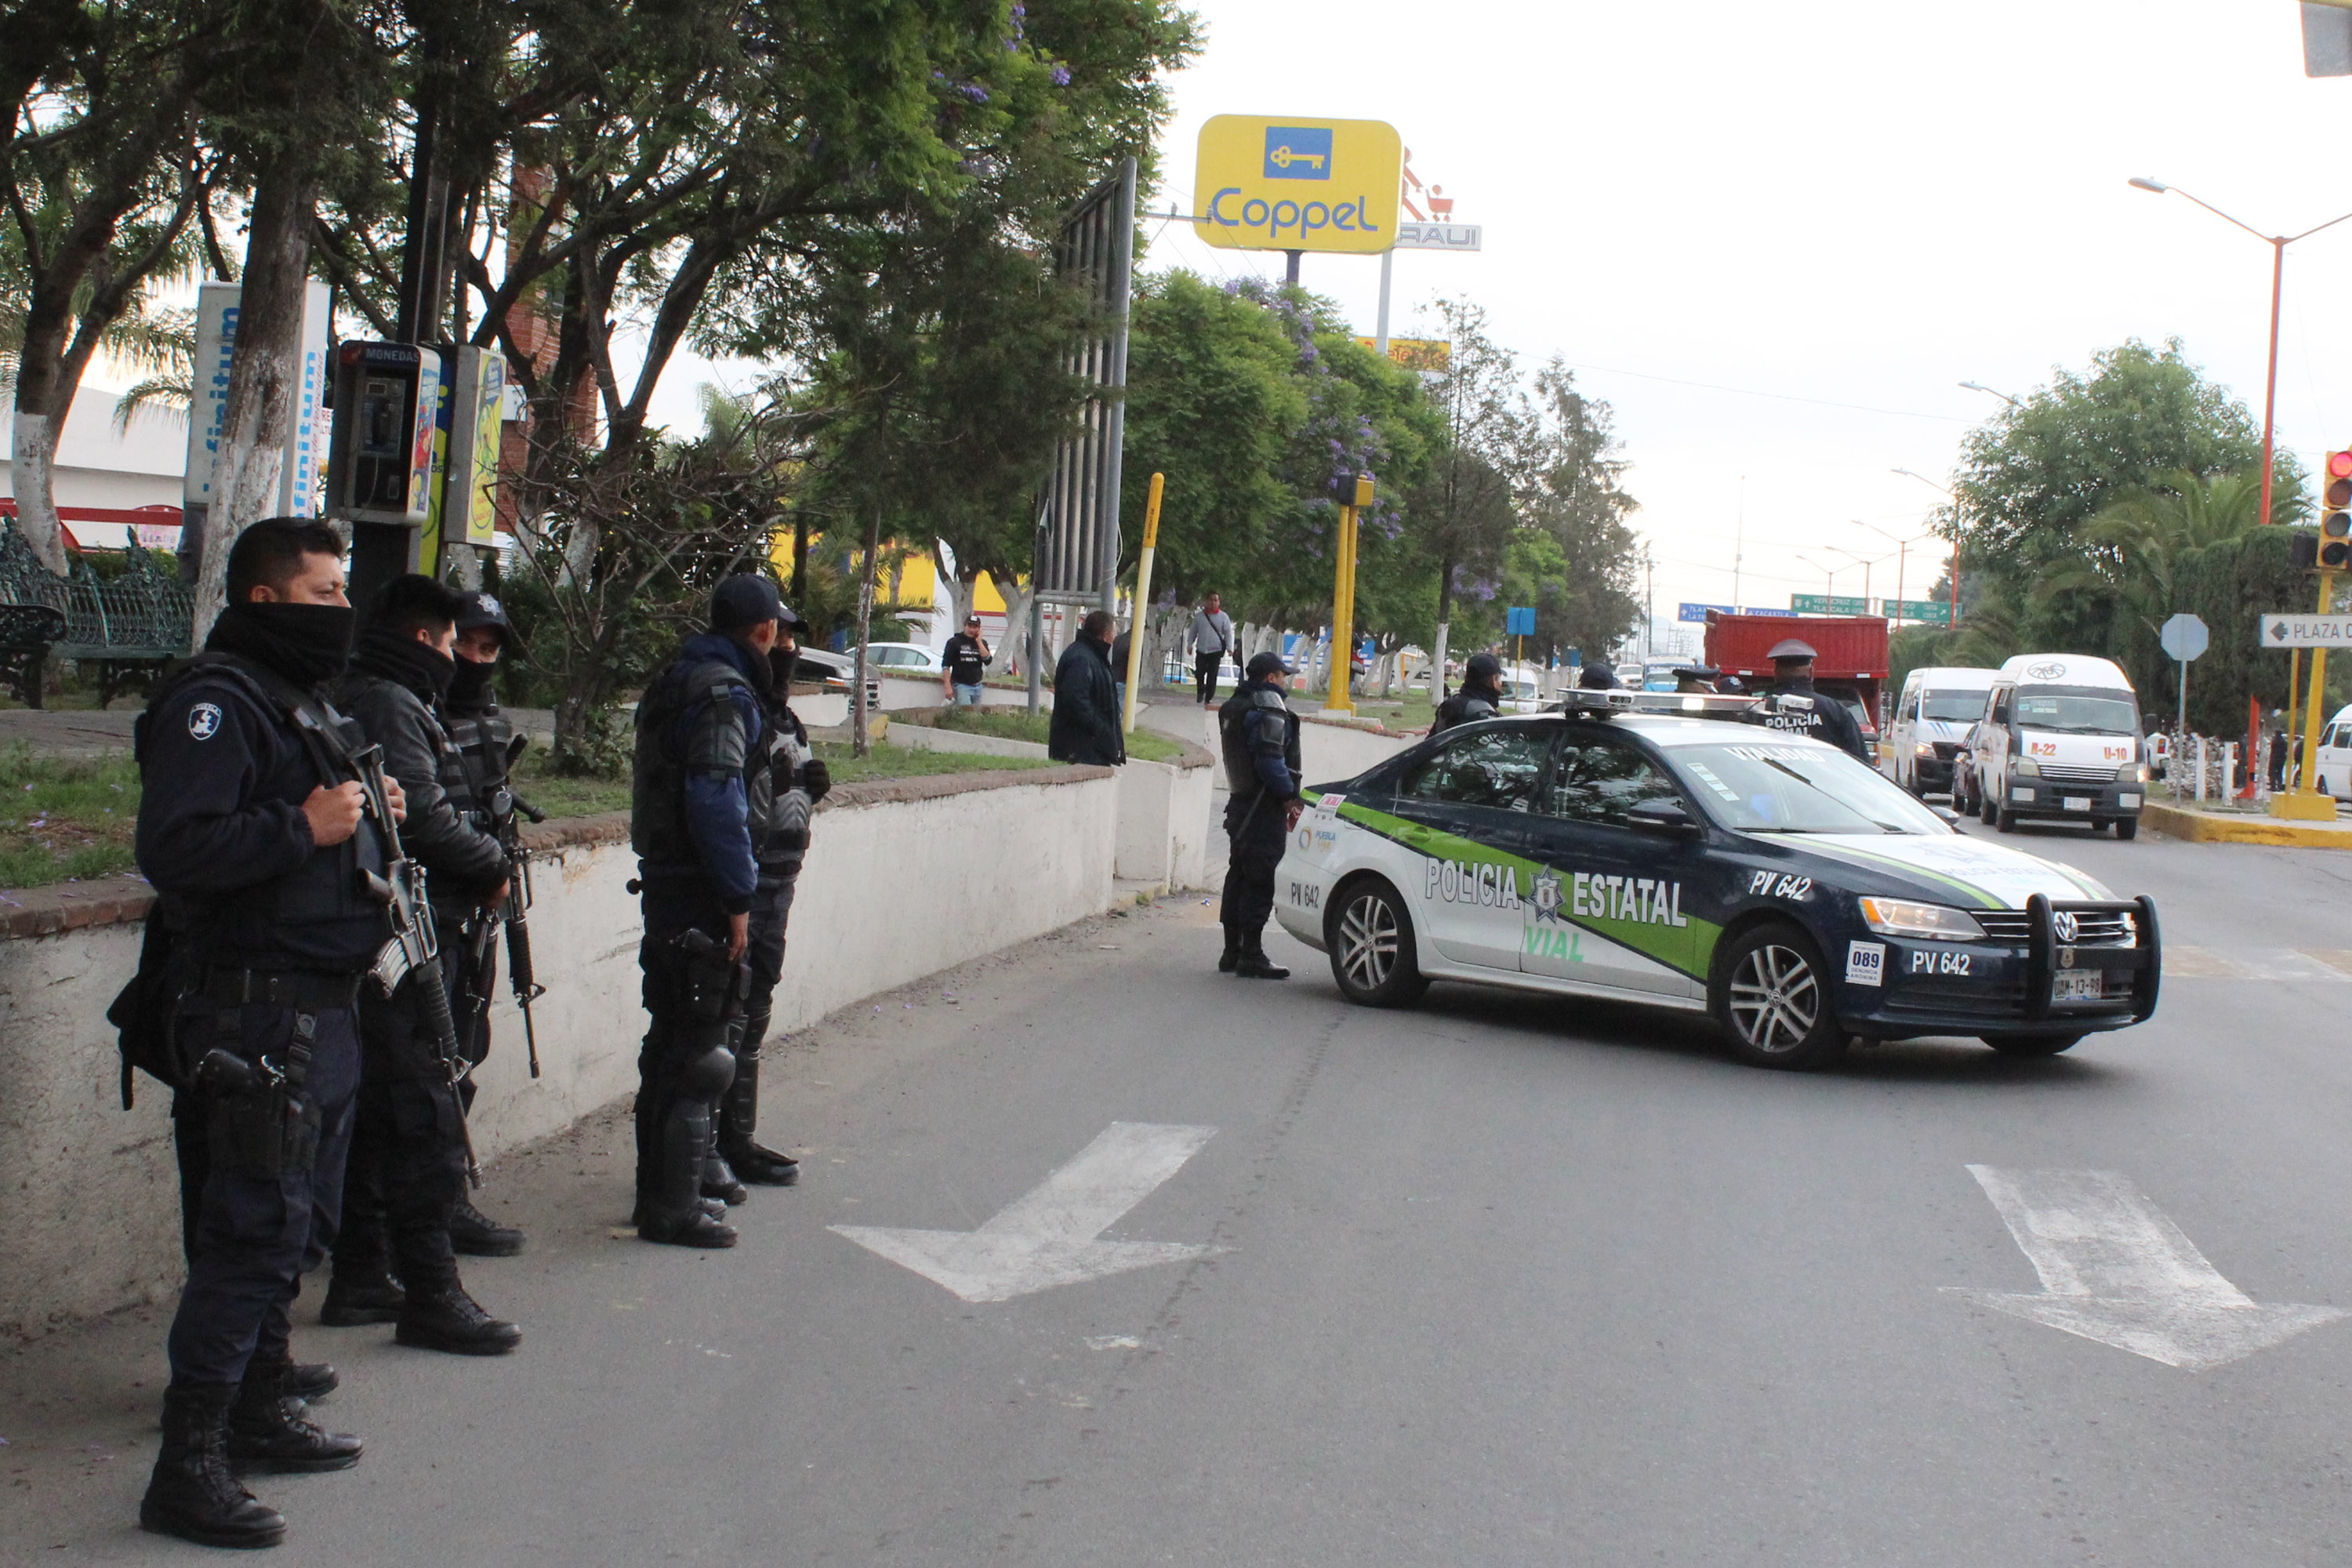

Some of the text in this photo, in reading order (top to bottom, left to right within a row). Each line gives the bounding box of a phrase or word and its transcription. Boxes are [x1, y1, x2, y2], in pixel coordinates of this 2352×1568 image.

[1211, 187, 1378, 239] Coppel
[365, 348, 419, 362] MONEDAS
[2294, 623, 2339, 639] PLAZA
[1766, 712, 1823, 728] POLICÍA
[1722, 746, 1825, 762] VIALIDAD
[2031, 742, 2056, 757] R-22
[2103, 746, 2128, 760] U-10
[1425, 856, 1688, 928] POLICIA ESTATAL
[1748, 869, 1813, 901] PV 642
[1291, 882, 1319, 909] PV 642
[1526, 925, 1584, 963] VIAL
[1853, 950, 1880, 968] 089
[1911, 950, 1971, 976] PV 642
